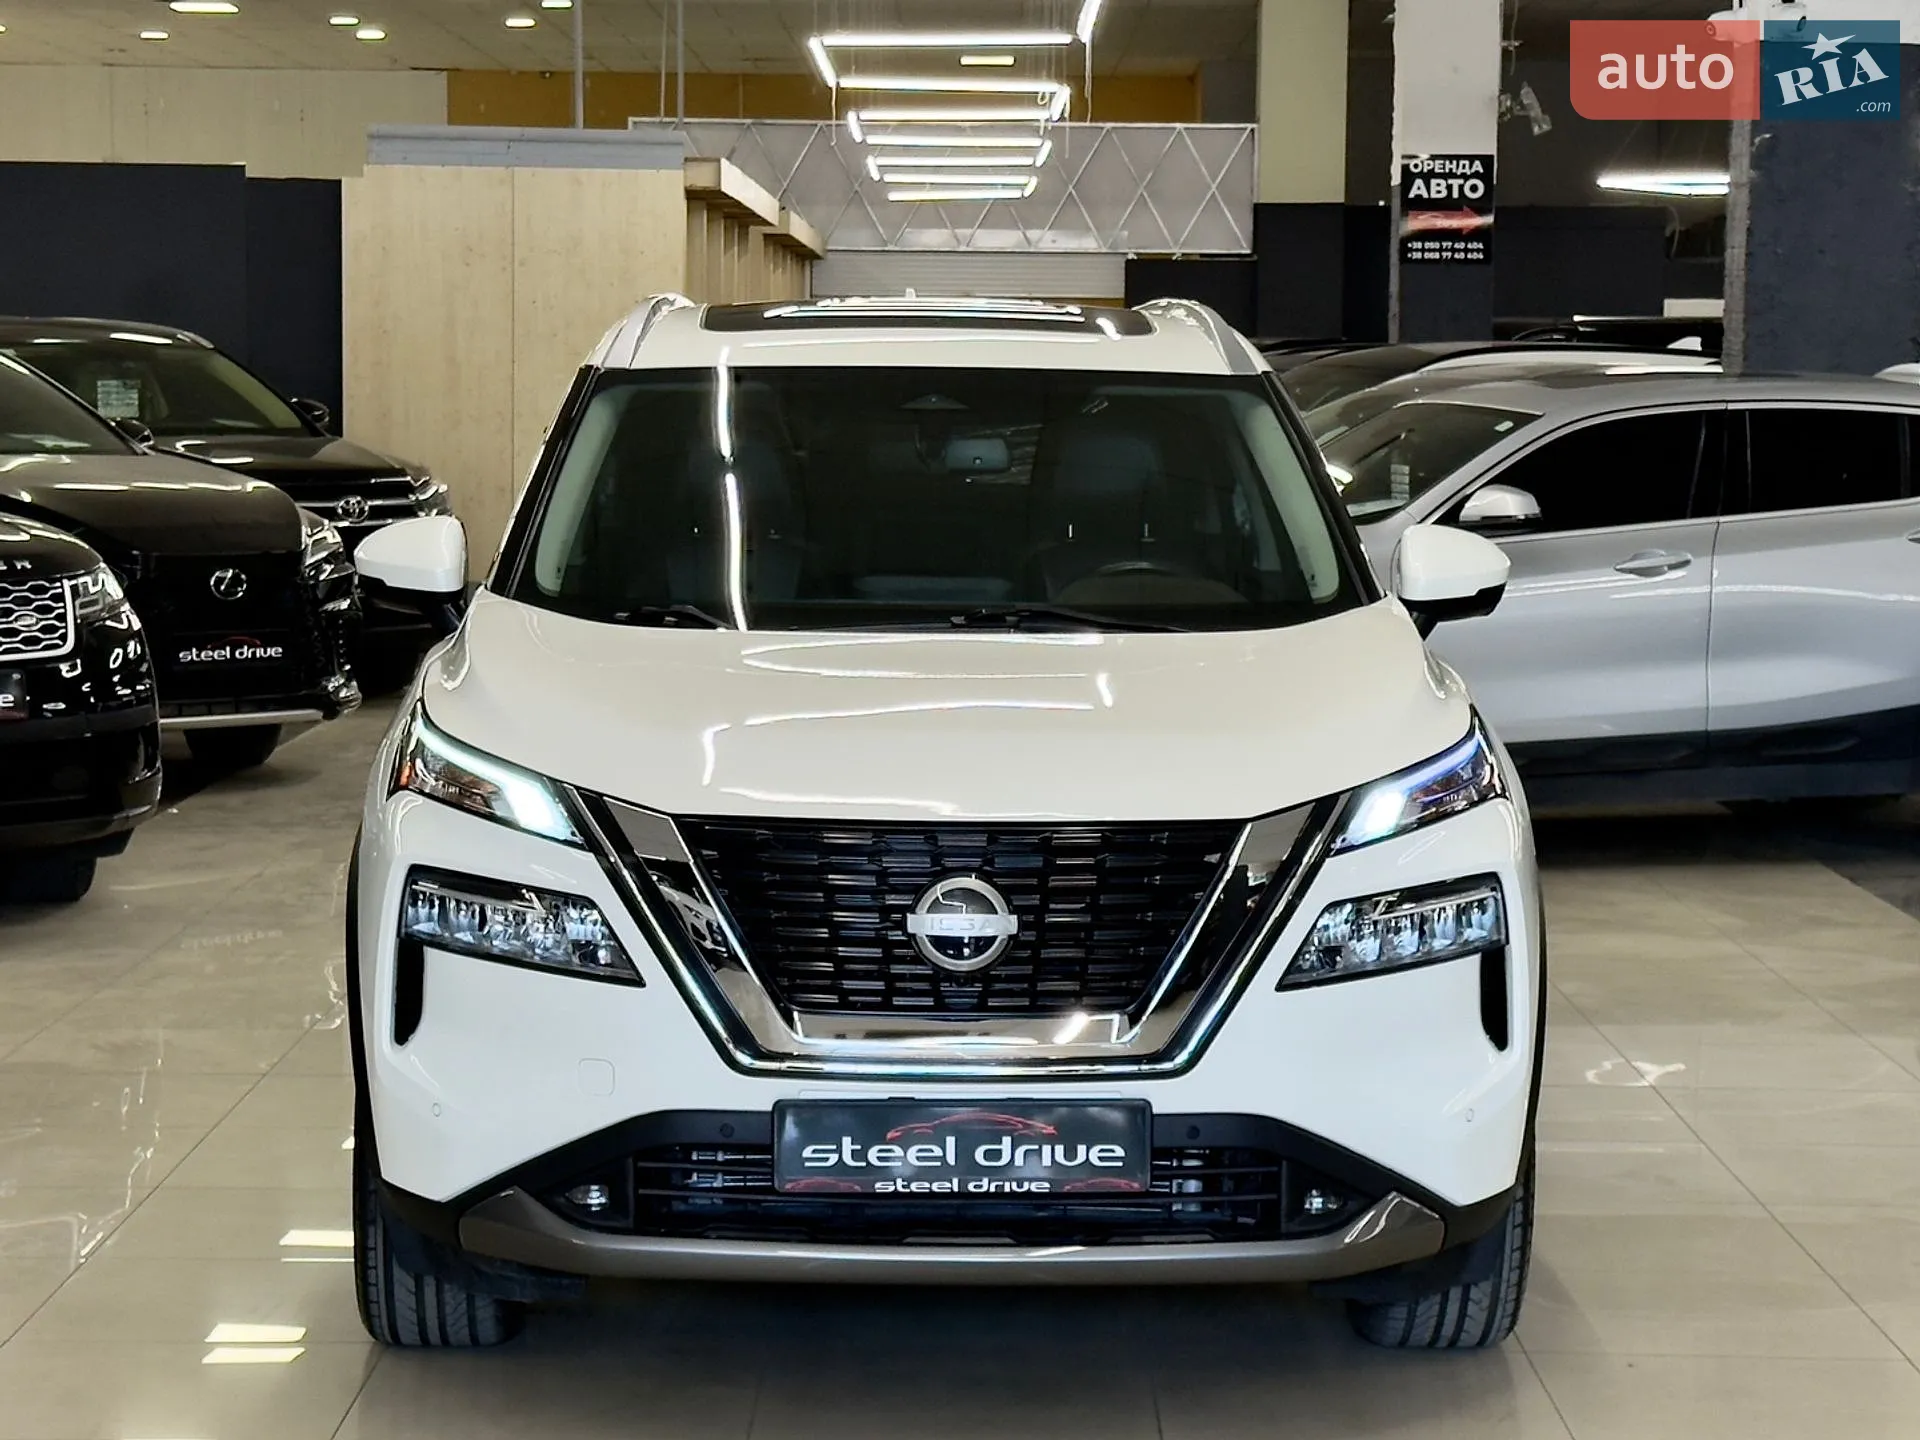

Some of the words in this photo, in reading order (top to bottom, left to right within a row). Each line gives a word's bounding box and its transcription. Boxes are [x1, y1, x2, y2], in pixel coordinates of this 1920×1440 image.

[1409, 159, 1484, 175] ОРЕНДА
[1407, 178, 1485, 199] АВТО
[179, 645, 231, 662] steel
[235, 644, 283, 659] drive
[801, 1136, 956, 1168] steel
[974, 1136, 1126, 1168] drive
[874, 1177, 959, 1193] steel
[967, 1177, 1051, 1193] drive
